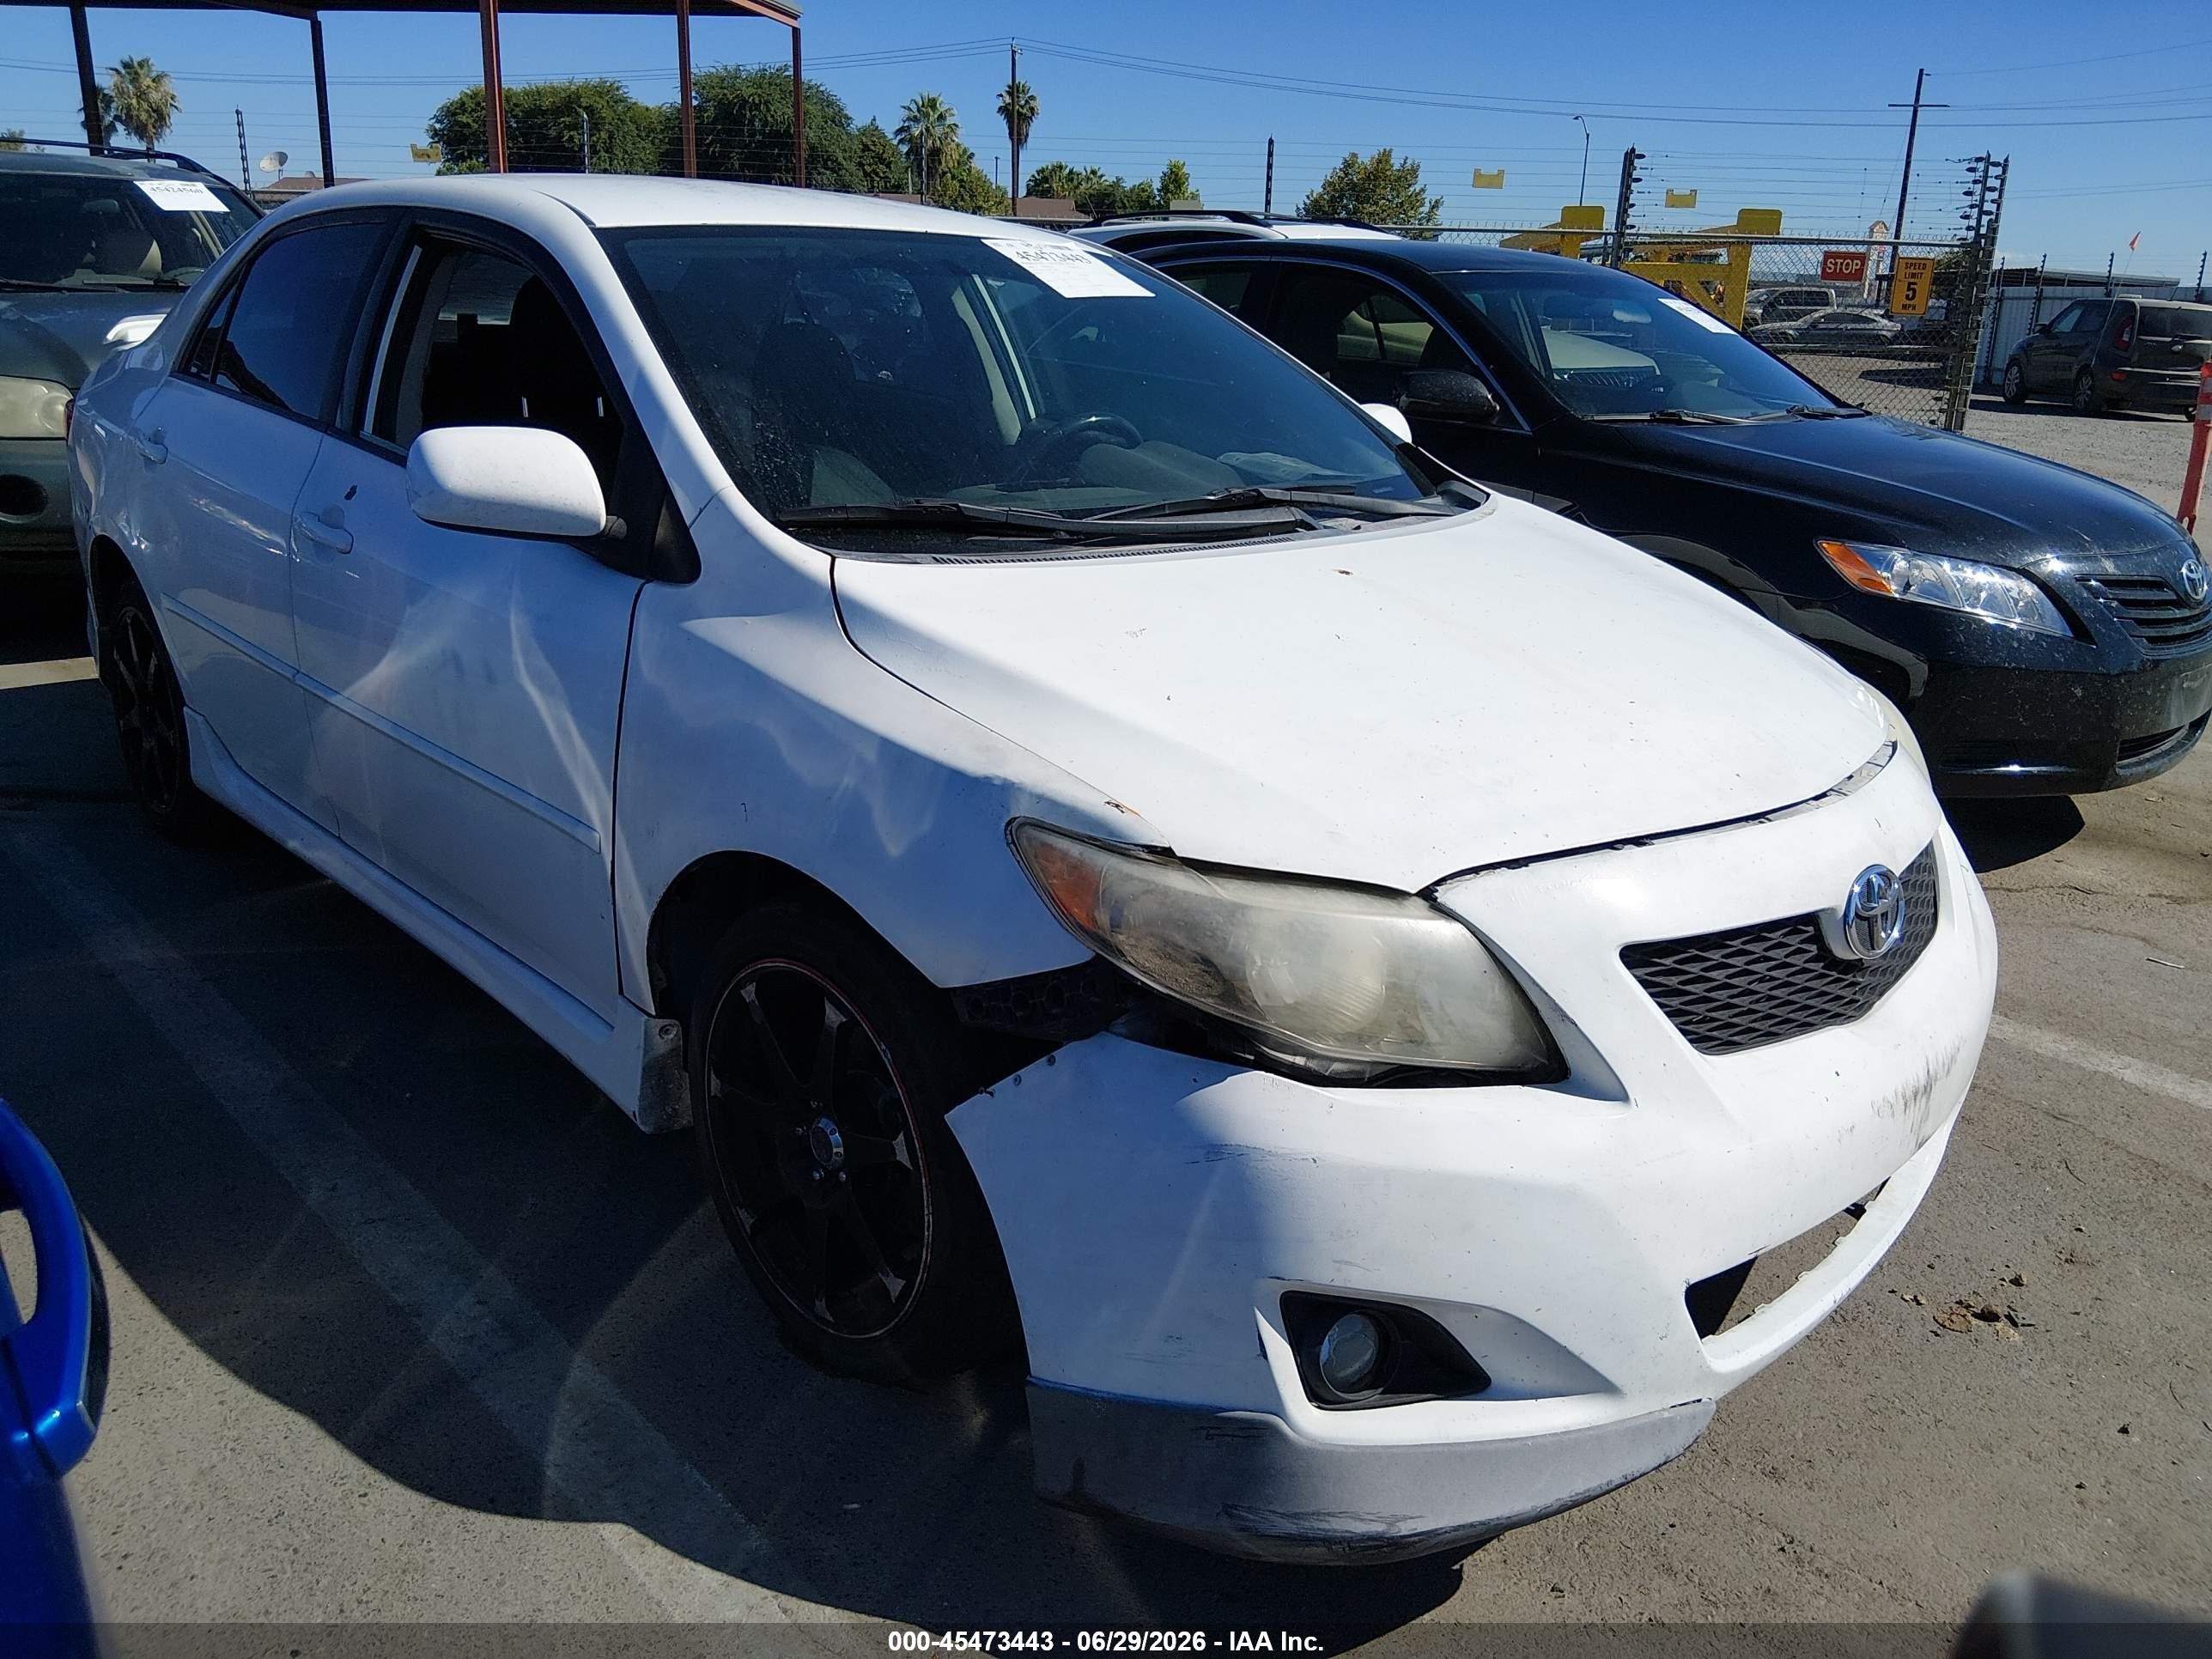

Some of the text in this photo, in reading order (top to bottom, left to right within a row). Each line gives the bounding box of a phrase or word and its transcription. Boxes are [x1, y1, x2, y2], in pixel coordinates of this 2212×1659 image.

[1826, 258, 1862, 274] STOP
[1904, 262, 1927, 270] SPEED
[1905, 282, 1917, 301] 5
